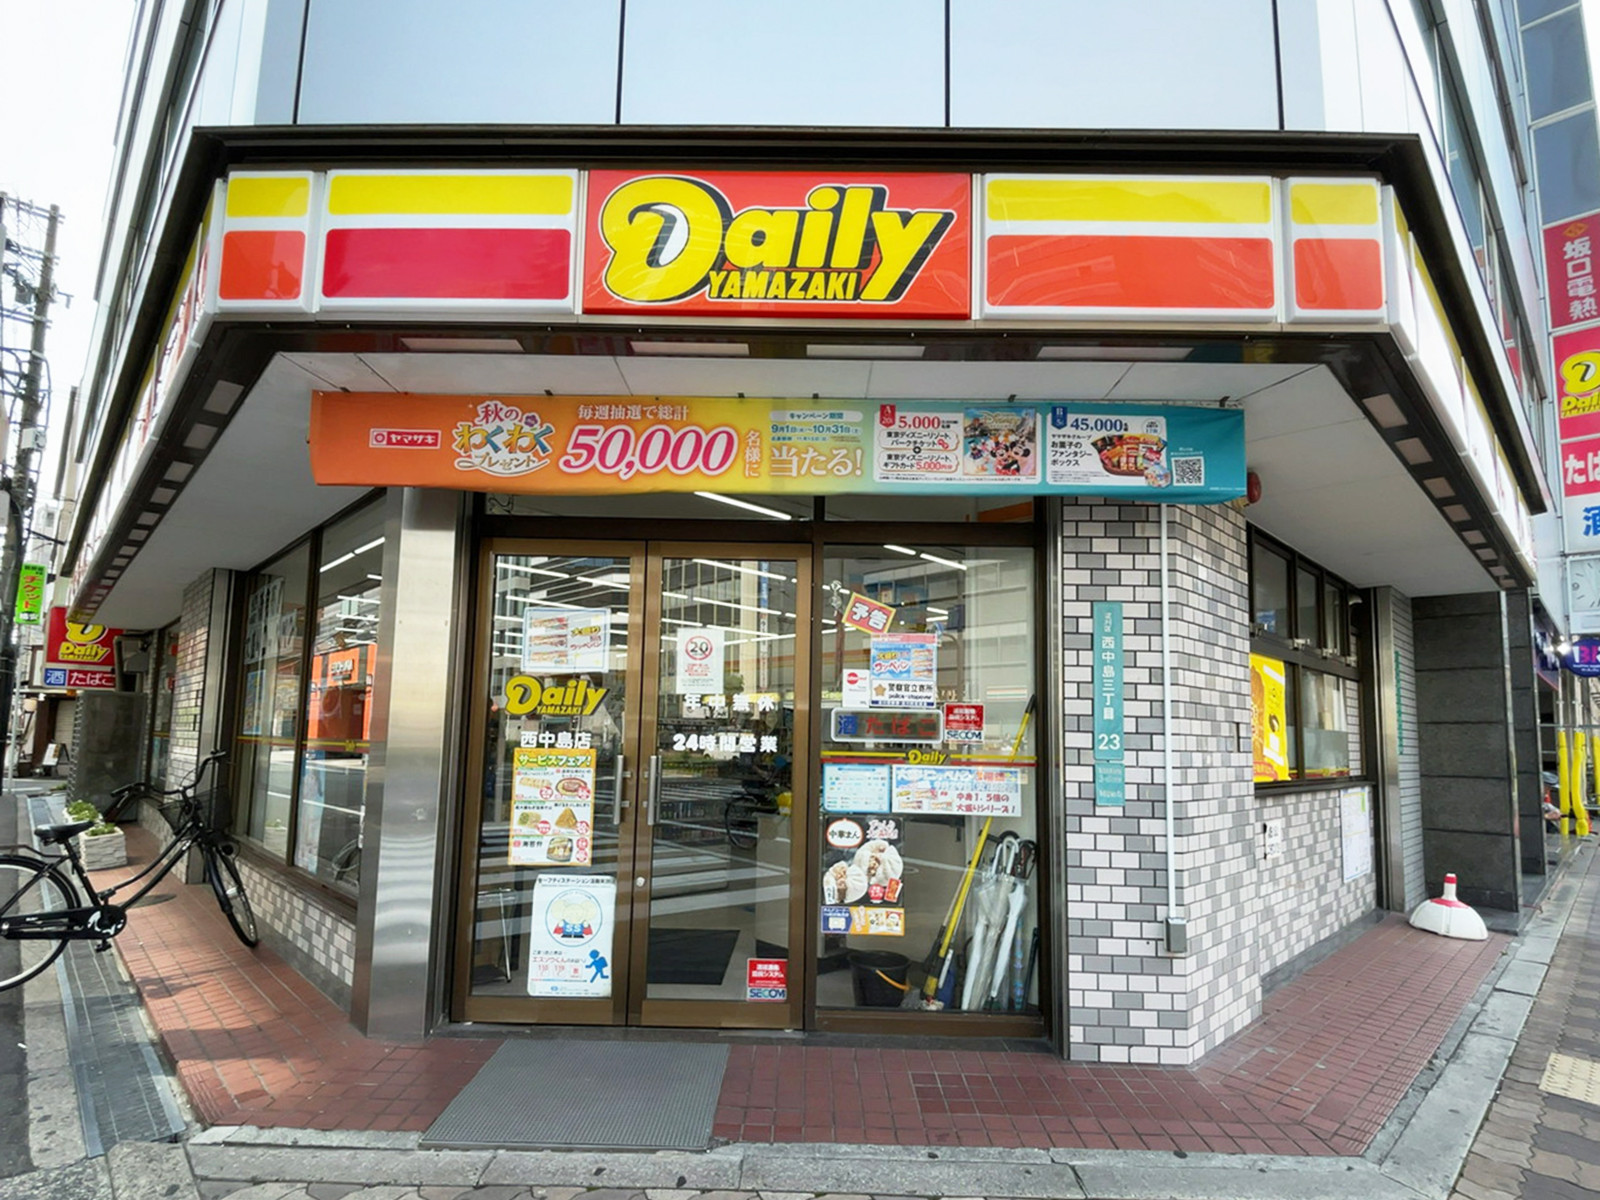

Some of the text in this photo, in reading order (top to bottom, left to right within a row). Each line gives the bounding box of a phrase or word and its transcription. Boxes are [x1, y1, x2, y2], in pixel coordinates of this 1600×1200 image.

[600, 175, 955, 303] Daily
[708, 270, 859, 300] YAMAZAKI
[479, 402, 521, 424] 秋の
[577, 404, 689, 421] 毎週抽選で総計
[789, 412, 844, 420] キャンペーン期間
[1070, 417, 1123, 432] 45,000
[389, 431, 437, 447] ヤマザキ
[455, 424, 555, 454] わくわく
[891, 439, 938, 447] パークチケット
[1051, 441, 1083, 449] お菓子の
[562, 427, 761, 477] 50,000 名様に
[1051, 450, 1092, 458] ファンタジー
[883, 461, 915, 470] ギフトカード
[1051, 459, 1080, 467] ボックス
[851, 601, 888, 630] 予告
[60, 642, 110, 662] Daily
[689, 641, 709, 654] 20
[46, 669, 115, 686] 酒 たばこ
[1102, 636, 1115, 720] 西中島三丁目
[505, 674, 611, 716] Daily
[888, 683, 933, 693] 警察官立寄所
[537, 706, 582, 715] YAMAZAKI
[684, 693, 775, 712] 年中無休
[838, 714, 937, 738] 酒 たばこ
[520, 730, 592, 749] 西中島店
[672, 732, 778, 753] 24時間営業
[947, 730, 982, 740] SECOM
[1098, 733, 1121, 750] 23
[518, 754, 592, 768] サービスフェア!
[907, 749, 949, 765] Daily
[828, 829, 861, 840] 中華まん
[749, 987, 786, 999] SECOM
